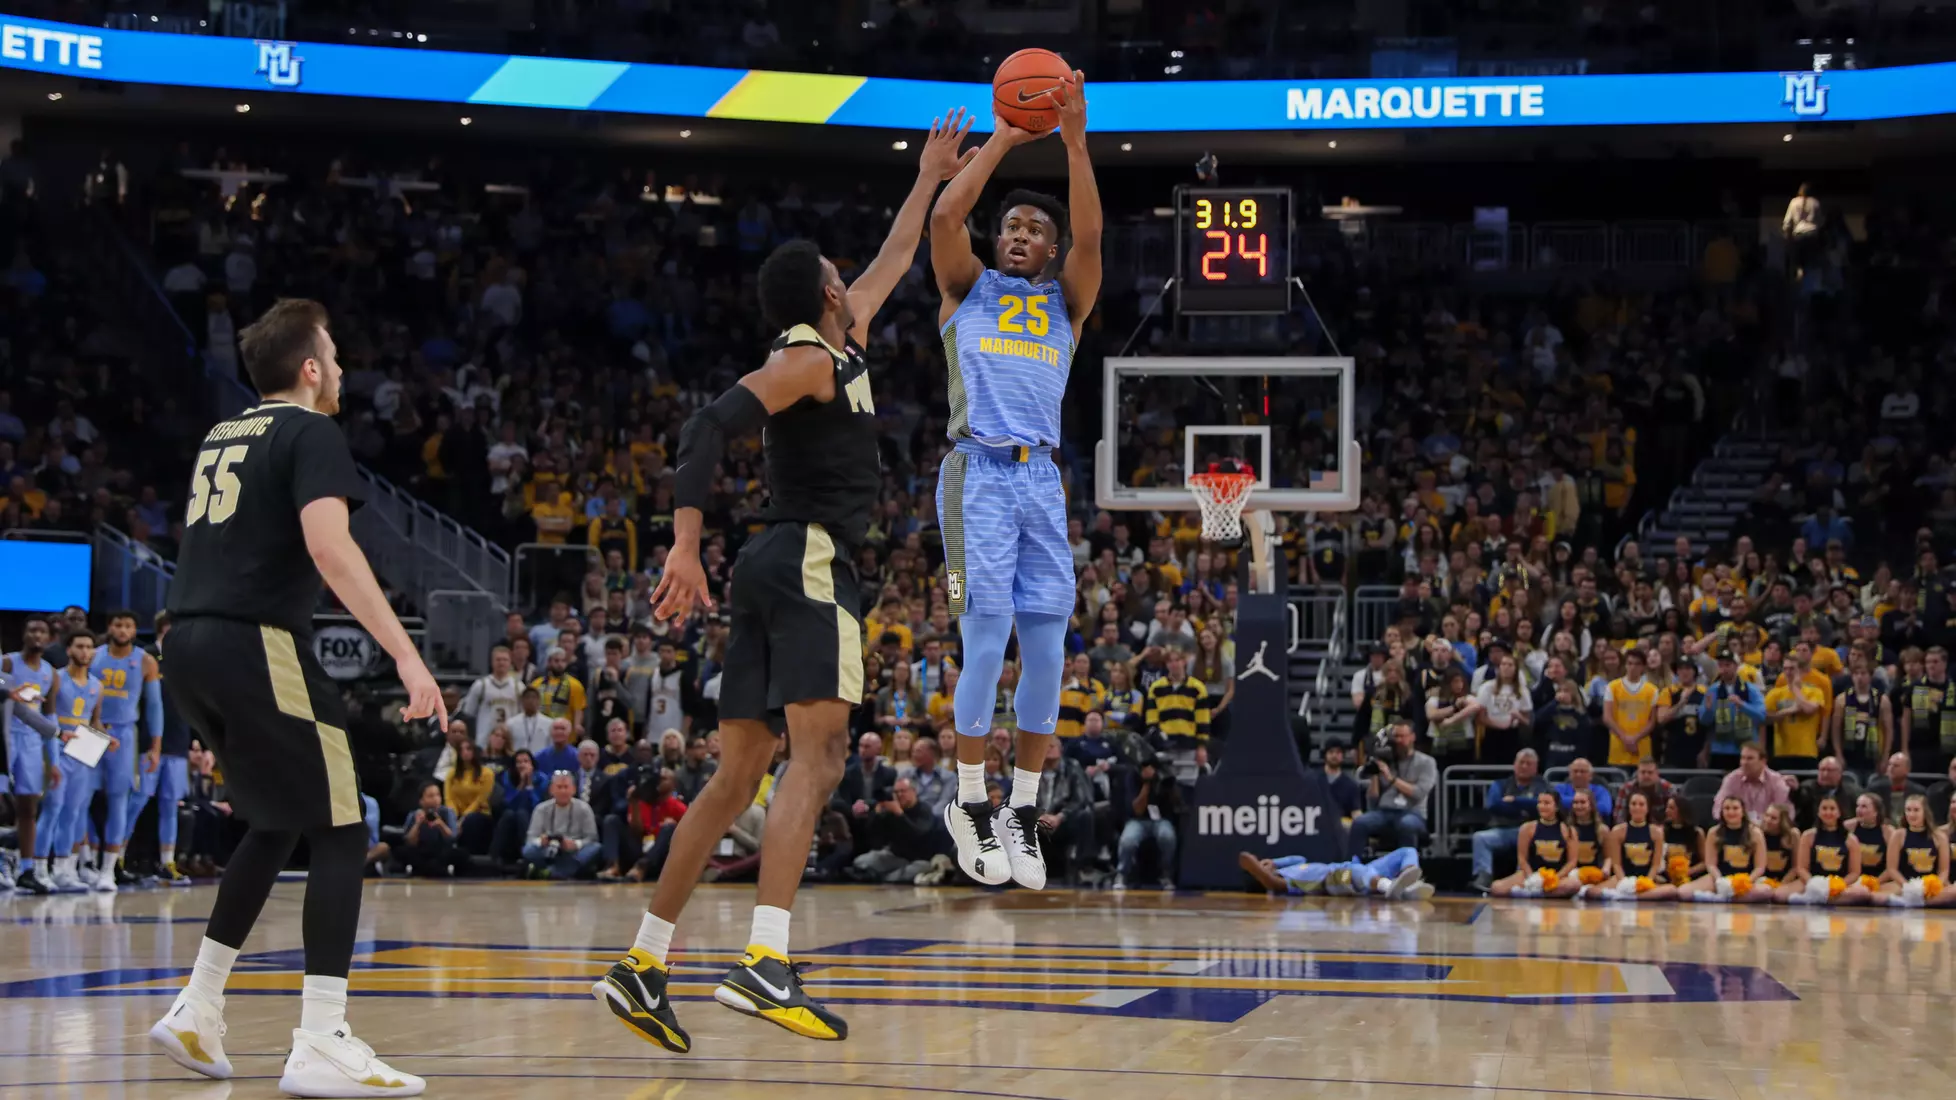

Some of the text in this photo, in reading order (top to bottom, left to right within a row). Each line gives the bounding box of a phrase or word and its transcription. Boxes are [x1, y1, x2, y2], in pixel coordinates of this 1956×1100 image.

[1, 23, 103, 70] ETTE
[254, 39, 305, 86] MU
[1287, 85, 1544, 120] MARQUETTE
[1779, 71, 1830, 116] MU
[1196, 199, 1257, 229] 31.9
[1202, 230, 1267, 281] 24
[998, 294, 1050, 337] 25
[979, 337, 1060, 368] MARQUETTE
[204, 416, 274, 442] STEFANOVIC
[186, 445, 249, 528] 55
[948, 570, 965, 602] MU
[320, 637, 362, 658] FOX
[101, 668, 127, 689] 30
[656, 698, 667, 715] 3
[1684, 716, 1698, 736] 3
[1855, 722, 1867, 741] 3
[1198, 794, 1322, 845] meijer
